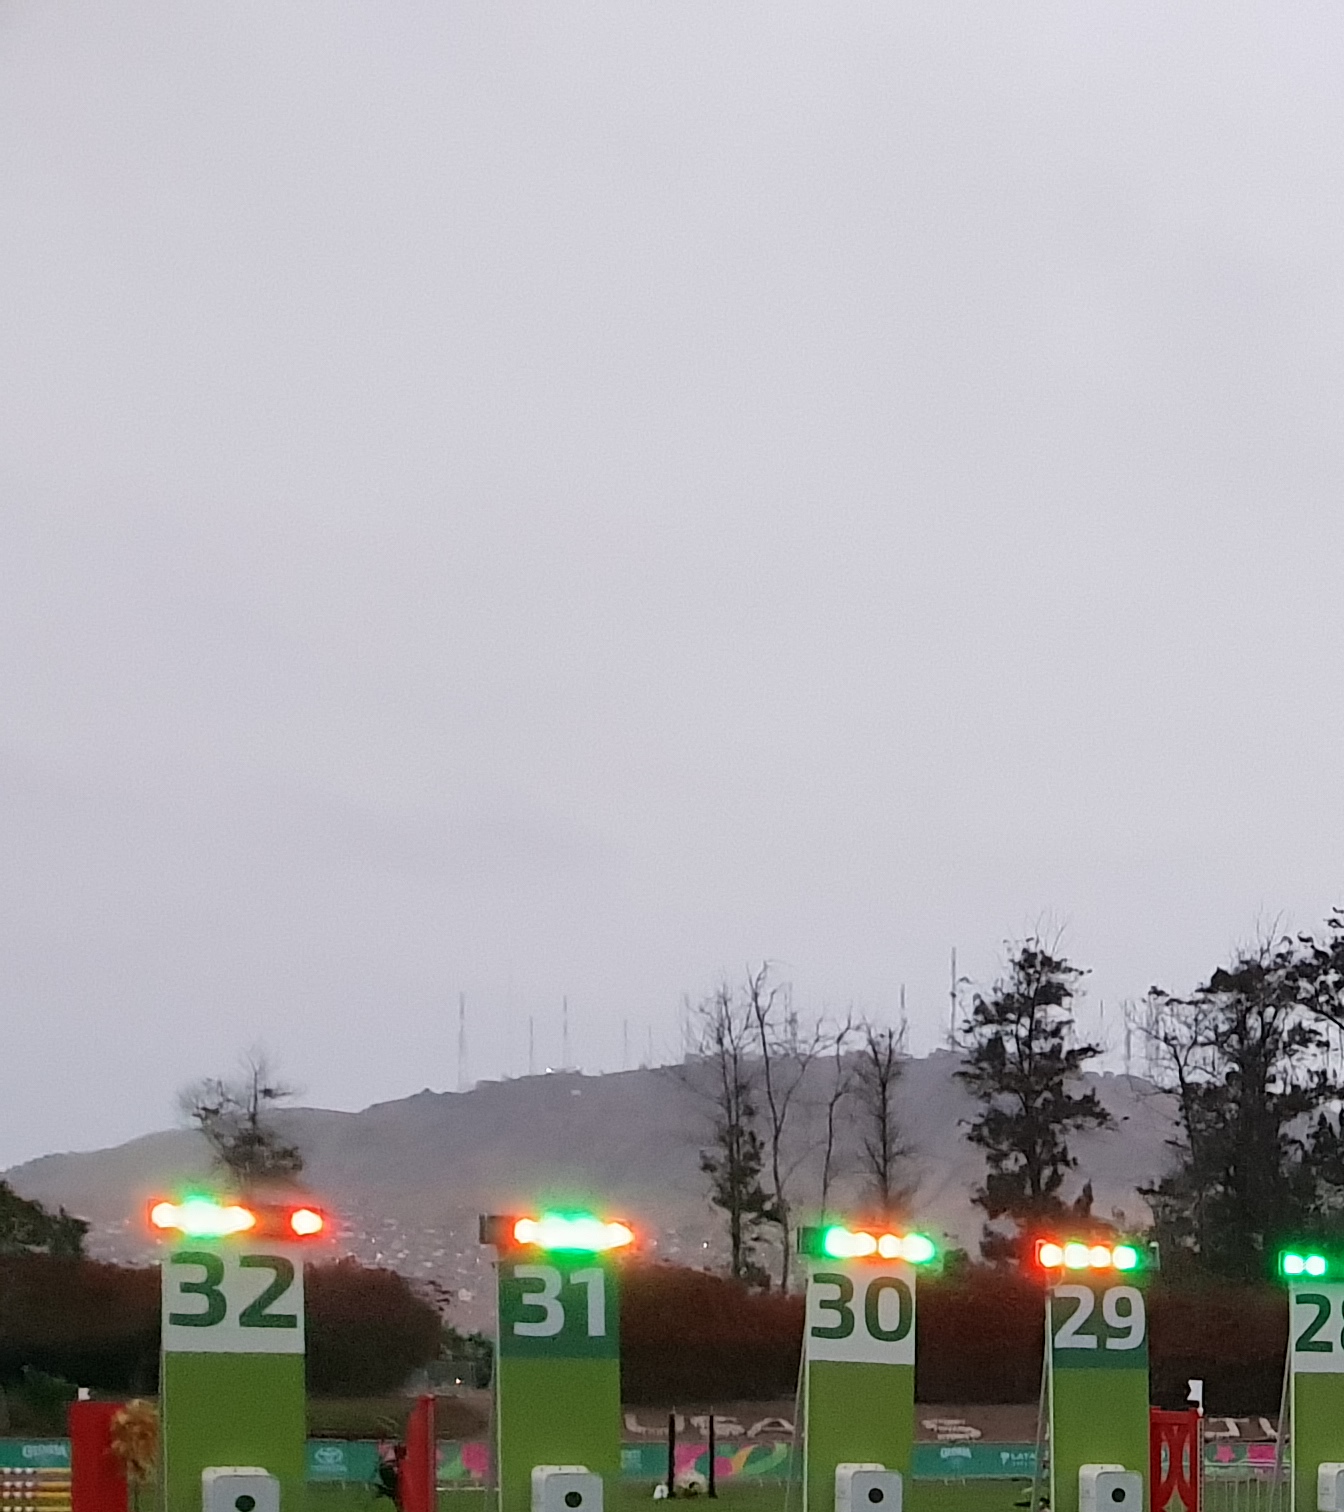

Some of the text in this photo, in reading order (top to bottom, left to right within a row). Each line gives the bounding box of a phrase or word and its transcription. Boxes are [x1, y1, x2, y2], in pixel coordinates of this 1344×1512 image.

[169, 1252, 298, 1329] 32
[514, 1267, 606, 1337] 31
[809, 1273, 912, 1342] 30
[1053, 1286, 1147, 1350] 29
